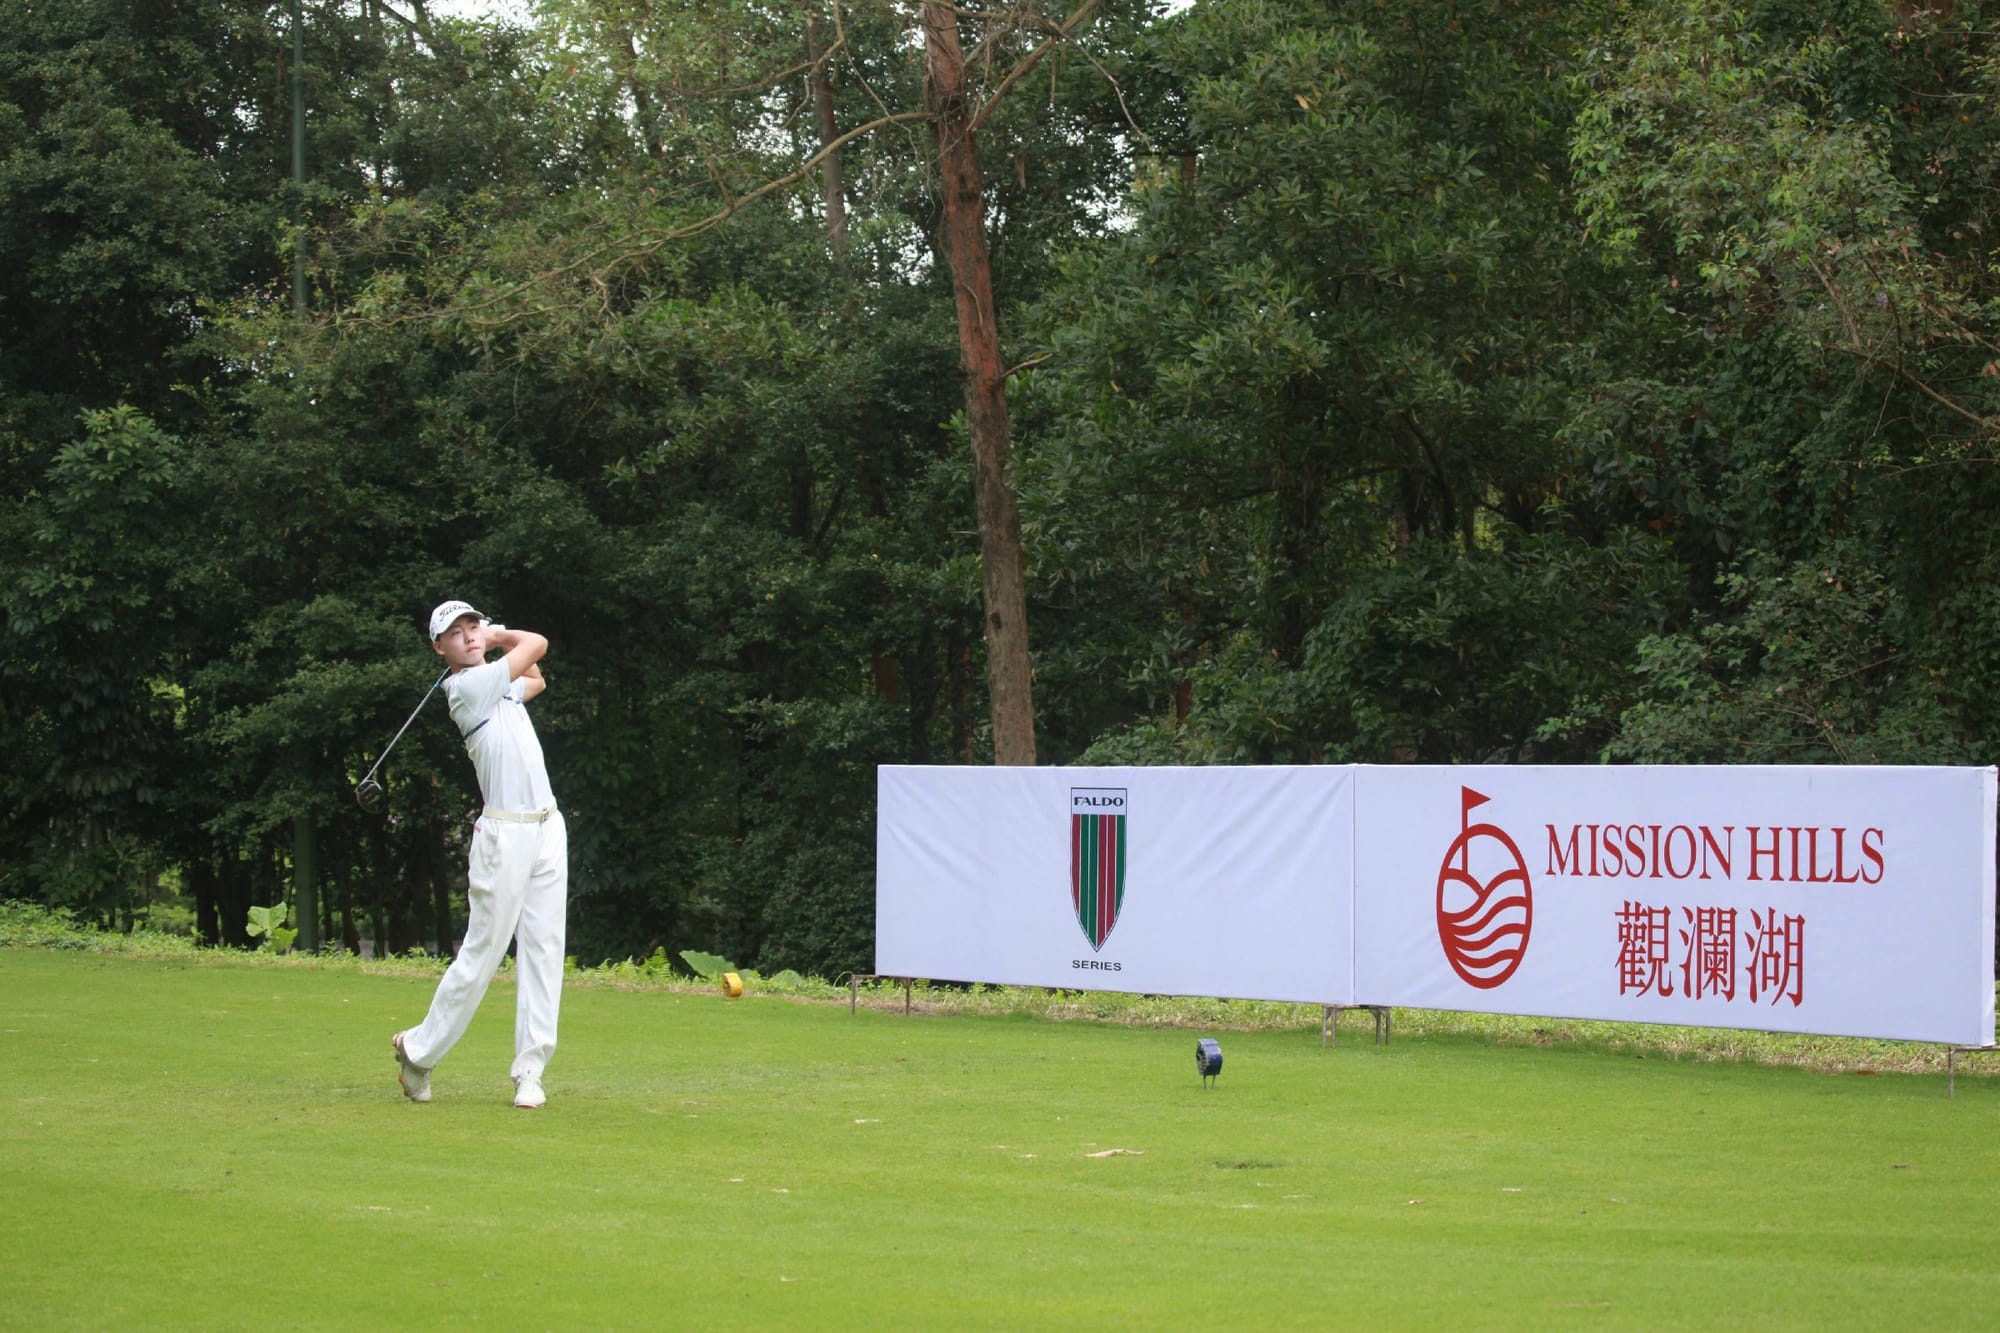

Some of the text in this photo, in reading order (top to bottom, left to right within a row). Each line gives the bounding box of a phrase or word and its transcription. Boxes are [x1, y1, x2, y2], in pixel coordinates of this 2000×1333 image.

[1073, 796, 1125, 807] FALDO
[1545, 823, 1885, 884] MISSION HILLS
[1071, 959, 1122, 972] SERIES
[1614, 900, 1806, 1008] 觀瀾湖
